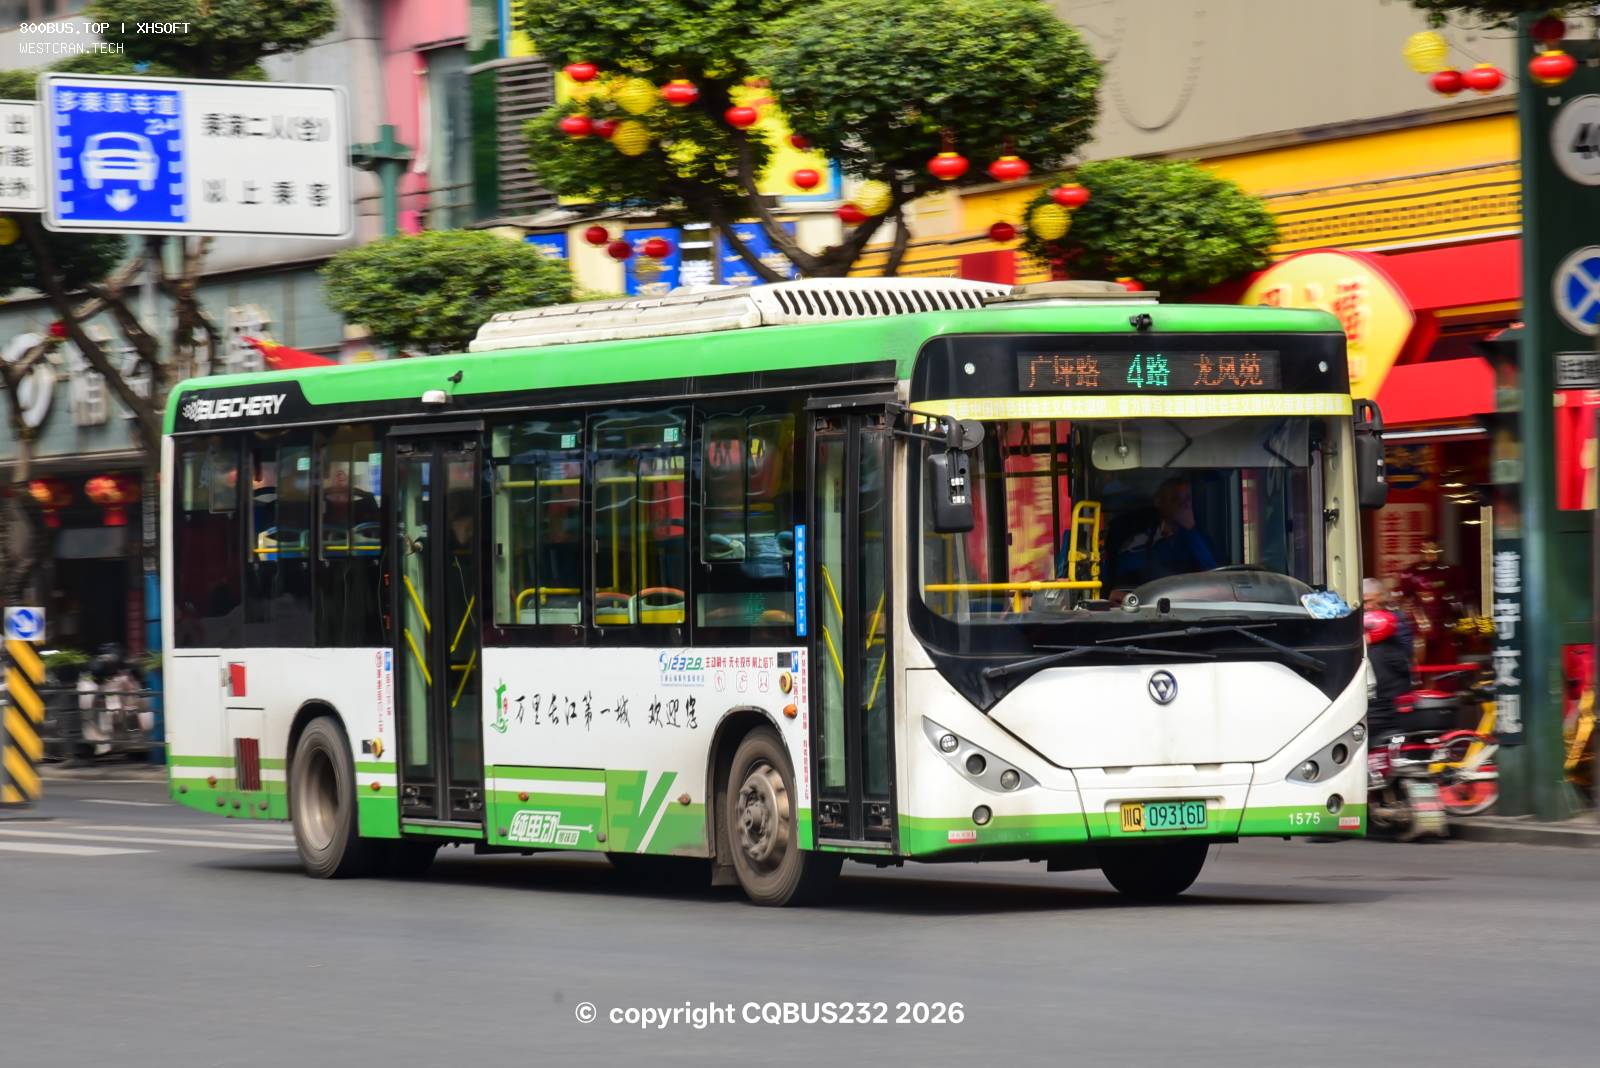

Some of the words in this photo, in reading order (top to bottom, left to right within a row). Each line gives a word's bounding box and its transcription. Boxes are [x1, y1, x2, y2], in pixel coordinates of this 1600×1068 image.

[1127, 353, 1170, 388] 4路
[514, 690, 631, 732] 万里长江第一城
[648, 694, 699, 729] 欢迎您
[1289, 812, 1320, 825] 1575
